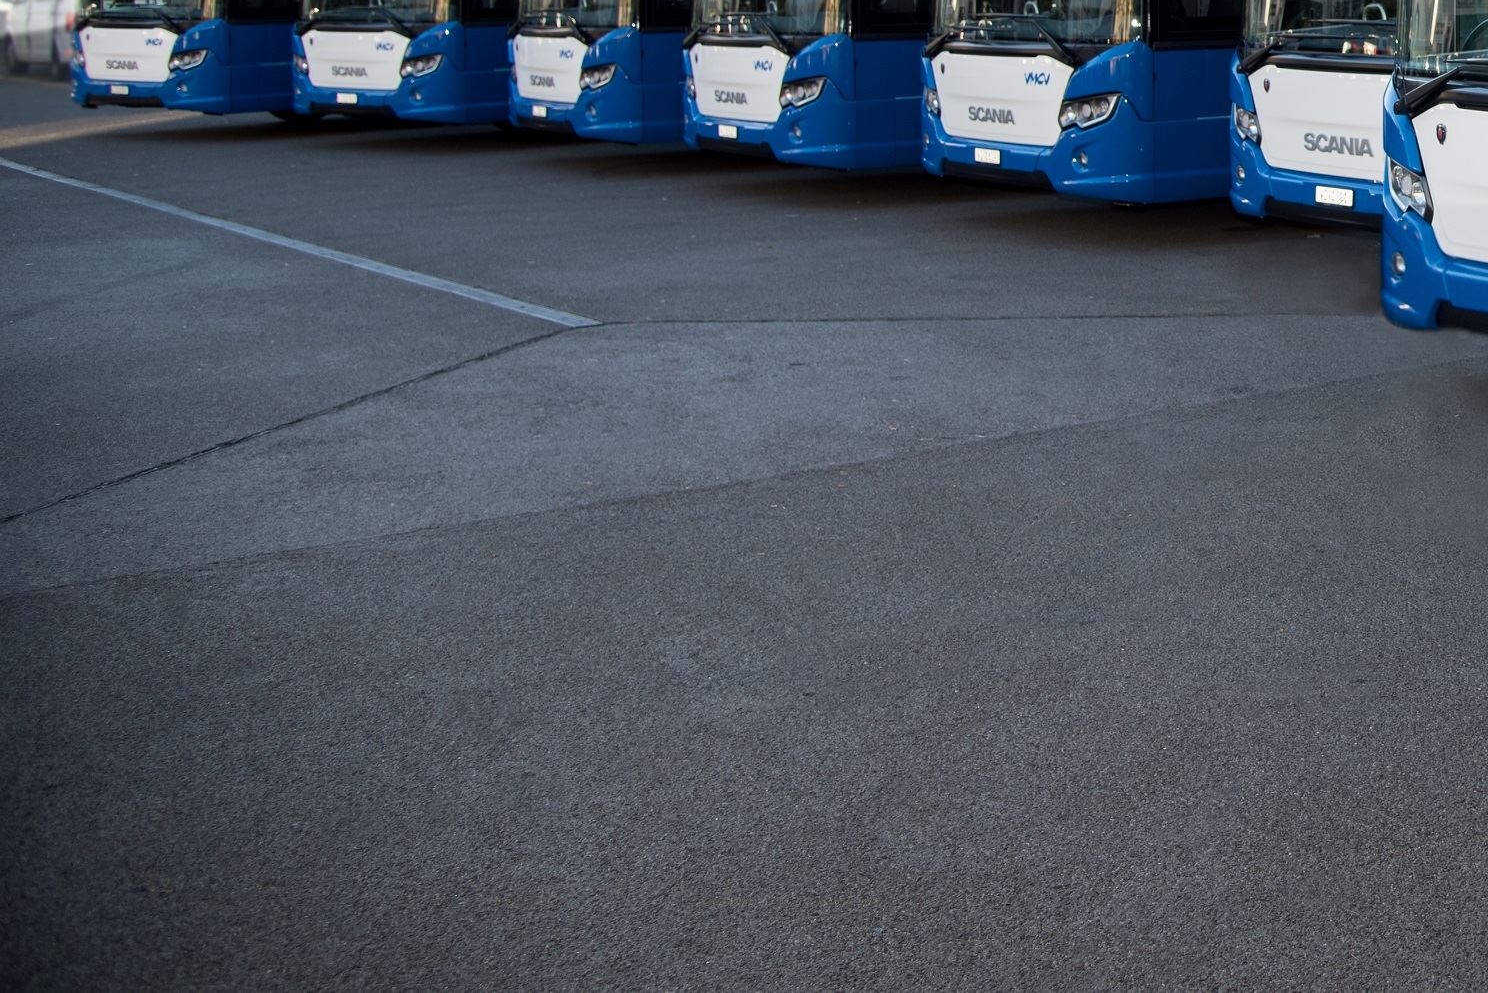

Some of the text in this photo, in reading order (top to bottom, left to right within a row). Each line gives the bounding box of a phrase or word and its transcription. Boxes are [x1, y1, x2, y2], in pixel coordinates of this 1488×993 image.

[105, 59, 139, 71] SCANIA
[331, 65, 368, 78] SCANIA
[1024, 71, 1051, 86] VMCV
[714, 89, 748, 106] SCANIA
[968, 105, 1016, 126] SCANIA
[1303, 132, 1374, 158] SCANIA
